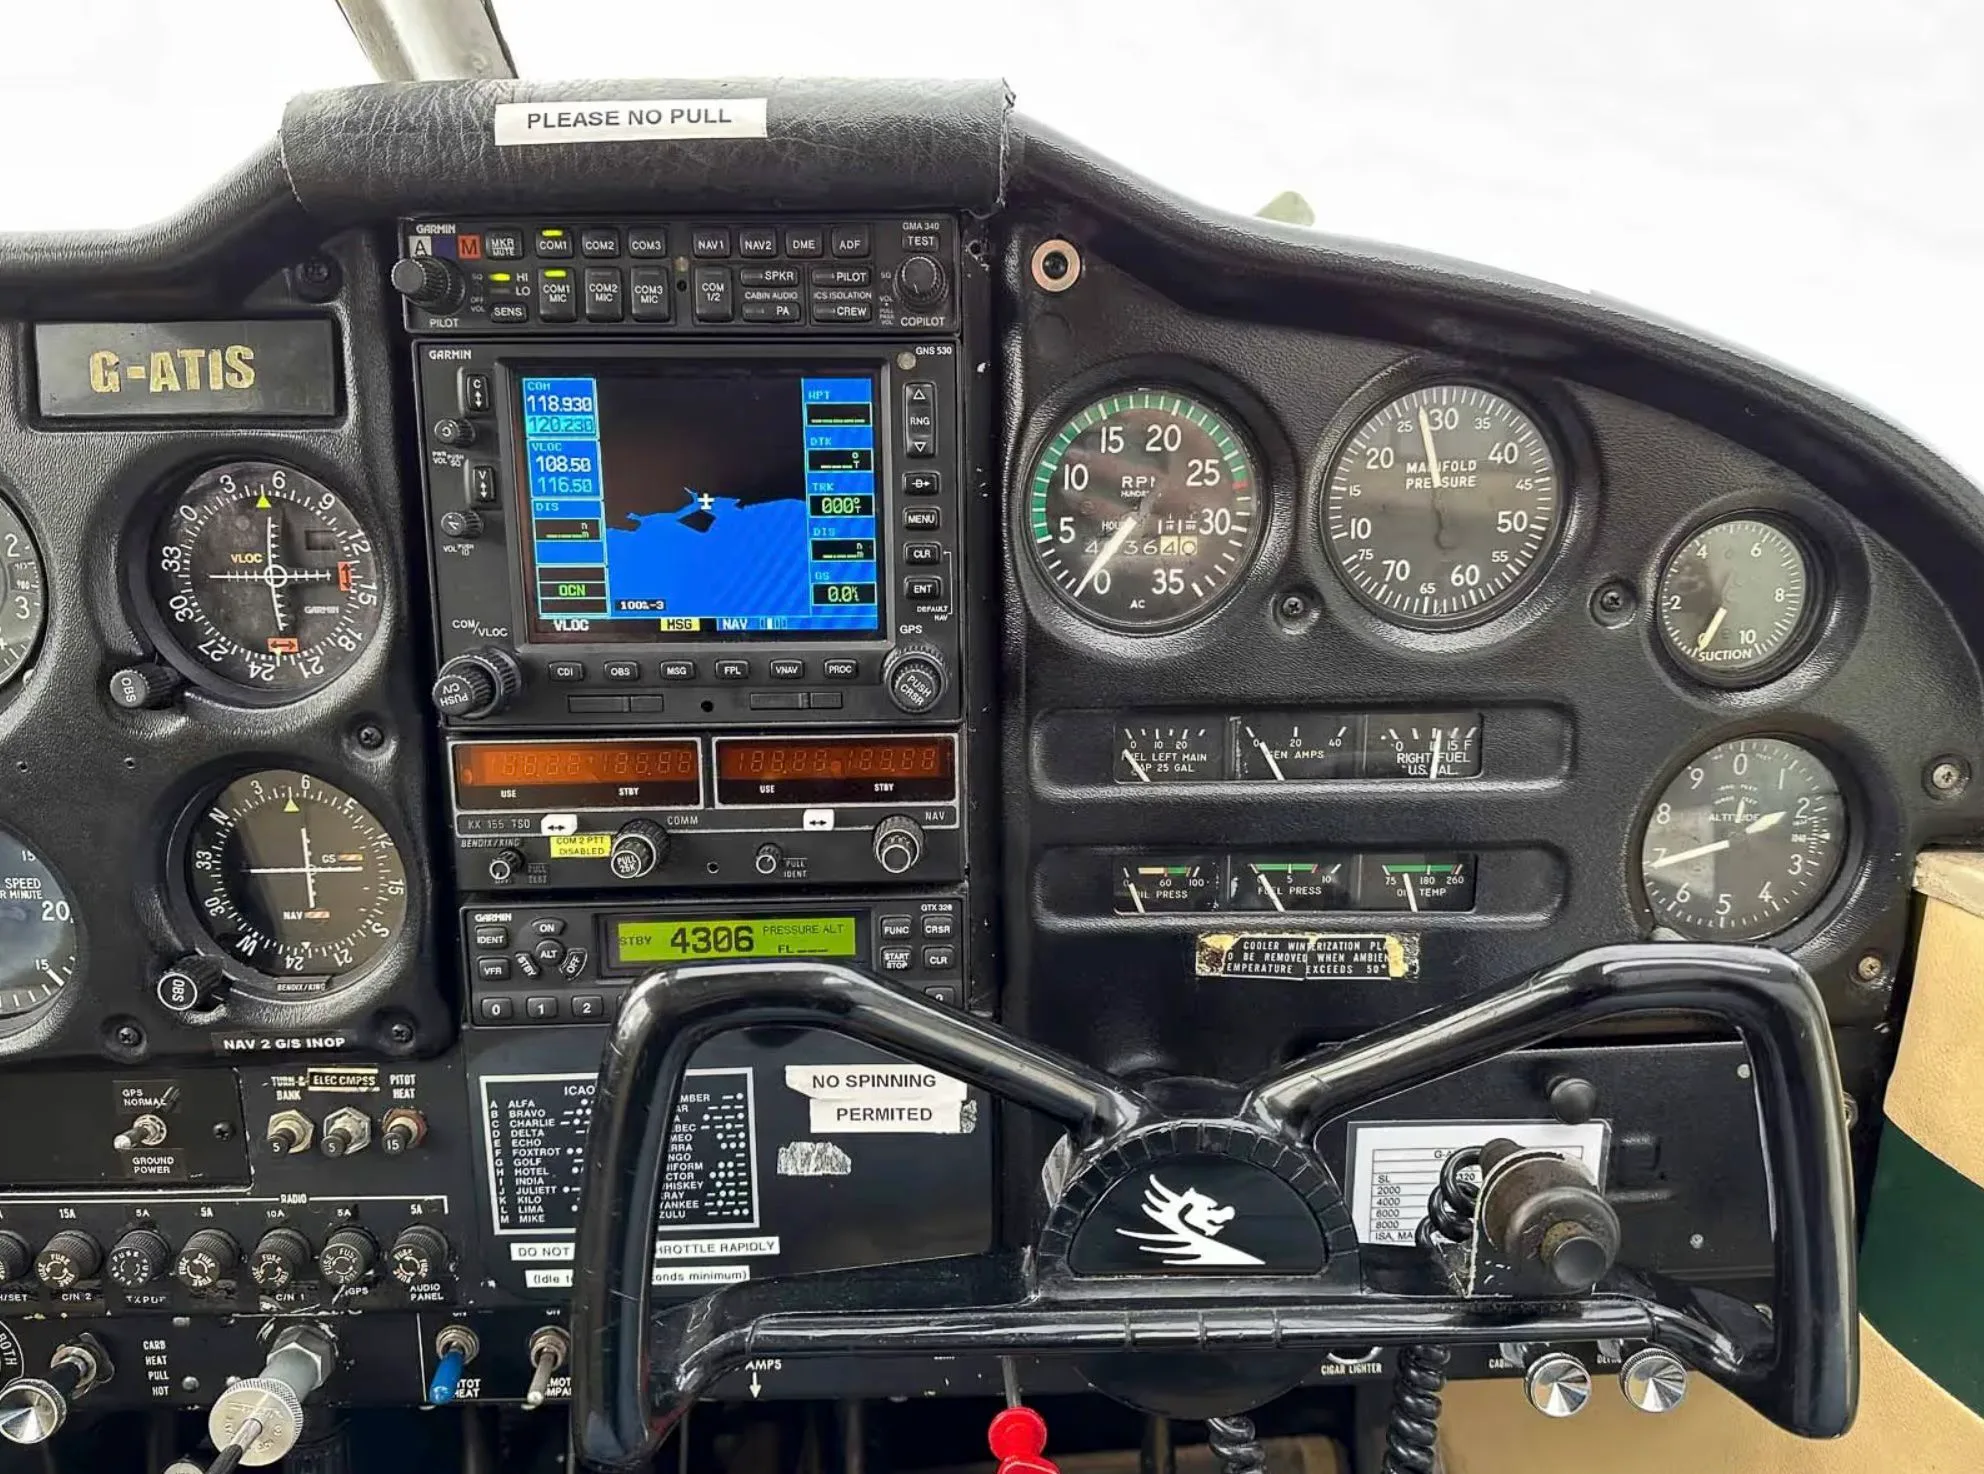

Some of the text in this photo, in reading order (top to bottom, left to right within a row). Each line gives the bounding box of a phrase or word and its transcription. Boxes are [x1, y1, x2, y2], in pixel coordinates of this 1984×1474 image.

[528, 108, 732, 129] PLEASE NO PULL
[416, 224, 456, 234] GARMIN
[903, 222, 939, 231] GMA 340
[539, 240, 567, 250] COM1
[585, 240, 614, 250] COM2
[632, 240, 661, 250] COM3
[698, 240, 724, 250] NAV1
[744, 240, 771, 250] NAV2
[792, 240, 816, 249] DME
[839, 240, 861, 250] ADF
[907, 236, 934, 246] TEST
[764, 271, 794, 281] SPKR
[836, 272, 866, 282] PILOT
[543, 284, 570, 294] COM1
[589, 284, 618, 293] COM2
[634, 285, 663, 295] COM3
[702, 282, 724, 292] COM
[494, 307, 522, 317] SENS
[776, 306, 790, 315] PA
[836, 306, 867, 316] CREW
[429, 318, 460, 328] PILOT
[900, 317, 946, 327] COPILOT
[429, 350, 472, 360] GARMIN
[916, 347, 952, 355] GNS 530
[89, 344, 256, 393] G-ATIS
[527, 395, 592, 412] 118.930
[910, 416, 930, 425] RNG
[1429, 408, 1459, 430] 30
[528, 416, 593, 432] 120.230
[1101, 427, 1124, 453] 15
[1146, 424, 1182, 451] 20
[1366, 447, 1394, 469] 20
[1488, 443, 1518, 464] 40
[536, 456, 591, 472] 108.50
[1186, 459, 1220, 486] 25
[1064, 464, 1089, 491] 10
[538, 477, 592, 493] 116.50
[1406, 476, 1476, 489] PRESURE
[908, 514, 935, 524] MENU
[1200, 508, 1231, 535] 30
[1497, 511, 1527, 532] 50
[1350, 518, 1371, 540] 10
[230, 553, 263, 564] VLOC
[913, 550, 931, 559] CLR
[1382, 560, 1410, 581] 70
[1451, 564, 1480, 586] 60
[1152, 569, 1184, 595] 35
[559, 584, 586, 597] OCN
[914, 585, 932, 593] ENT
[554, 620, 589, 631] VLOC
[900, 625, 922, 634] GPS
[1739, 630, 1756, 644] 10
[1699, 649, 1751, 661] SUCTION
[611, 667, 630, 676] OBS
[667, 666, 686, 675] MSG
[724, 666, 741, 674] FPL
[776, 666, 798, 674] VNAV
[829, 665, 851, 674] PROC
[1152, 753, 1207, 762] LEFT MAIN
[1295, 750, 1324, 759] AMPS
[1397, 753, 1432, 763] RIGHT
[1157, 764, 1195, 772] 25 GAL
[925, 811, 945, 820] NAV
[468, 820, 480, 829] KX
[667, 816, 699, 825] COMM
[556, 837, 577, 845] COM
[559, 847, 605, 855] DISABLED
[5, 878, 41, 889] SPEED
[1189, 879, 1204, 887] 100
[1420, 876, 1435, 884] 180
[1446, 876, 1464, 884] 260
[10, 890, 43, 899] MINUTE
[1156, 891, 1188, 899] PRESS
[1290, 887, 1322, 895] PRESS
[1419, 888, 1447, 897] TEMP
[1716, 894, 1732, 915] 5
[42, 900, 70, 921] 20
[475, 913, 512, 922] GARMIN
[763, 924, 844, 935] PRESSURE ALT
[885, 926, 909, 934] FUNC
[926, 925, 950, 933] CRSR
[477, 936, 504, 944] IDENT
[669, 925, 754, 954] 4306
[1243, 942, 1279, 950] COOLER
[540, 950, 556, 958] ALT
[1243, 952, 1345, 962] BE REMOVED WHEN
[929, 956, 948, 964] CLR
[1306, 965, 1353, 974] EXCEEDS
[224, 1038, 257, 1049] NAV
[261, 1038, 270, 1049] 2
[306, 1038, 345, 1048] INOP
[389, 1074, 416, 1085] PITOT
[812, 1074, 936, 1088] NO SPINNING
[122, 1088, 143, 1097] GPS
[276, 1090, 301, 1100] BANK
[392, 1088, 415, 1099] HEAT
[564, 1085, 595, 1096] ICAO
[124, 1098, 167, 1107] NORMAL
[508, 1100, 535, 1108] ALFA
[509, 1109, 545, 1118] BRAVO
[836, 1108, 932, 1121] PERMITED
[510, 1119, 555, 1128] CHARLIE
[511, 1129, 545, 1137] DELTA
[512, 1139, 541, 1147] ECHO
[512, 1148, 561, 1157] FOXTROT
[132, 1156, 174, 1165] GROUND
[513, 1158, 542, 1166] GOLF
[134, 1166, 170, 1174] POWER
[514, 1167, 549, 1176] HOTEL
[516, 1177, 545, 1185] INDIA
[516, 1186, 557, 1195] JULIETT
[1377, 1186, 1401, 1195] 2000
[281, 1194, 307, 1203] RADIO
[517, 1196, 542, 1204] KILO
[1376, 1197, 1400, 1206] 4000
[59, 1209, 76, 1219] 15A
[518, 1205, 544, 1214] LIMA
[1375, 1209, 1400, 1218] 6000
[519, 1214, 545, 1223] MIKE
[1375, 1220, 1399, 1229] 8000
[518, 1247, 570, 1257] DO NOT
[689, 1271, 746, 1280] minimum)
[410, 1284, 441, 1292] AUDIO
[410, 1292, 443, 1301] PANEL
[143, 1340, 166, 1350] CARB
[146, 1356, 167, 1365] HEAT
[1321, 1363, 1382, 1376] CIGAR LIGHTER
[148, 1371, 169, 1380] PULL
[152, 1386, 169, 1396] HOT
